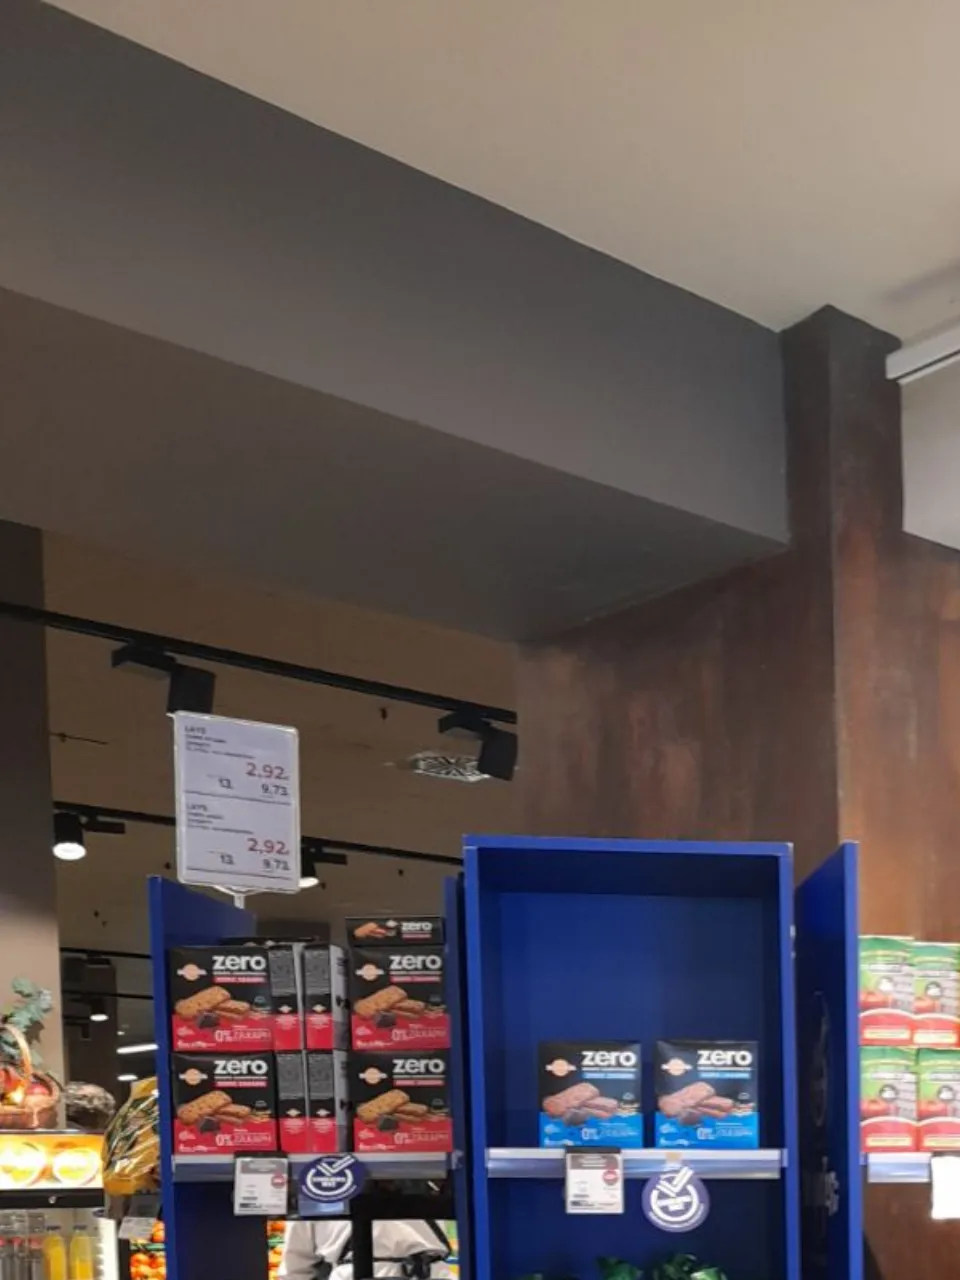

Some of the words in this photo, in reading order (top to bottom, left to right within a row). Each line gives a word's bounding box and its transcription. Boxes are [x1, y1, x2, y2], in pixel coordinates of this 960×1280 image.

[401, 921, 433, 932] zero
[212, 954, 267, 970] zero
[389, 954, 442, 970] zero
[392, 1057, 445, 1074] zero
[581, 1050, 637, 1067] zero
[697, 1049, 753, 1066] zero
[214, 1058, 268, 1075] zero
